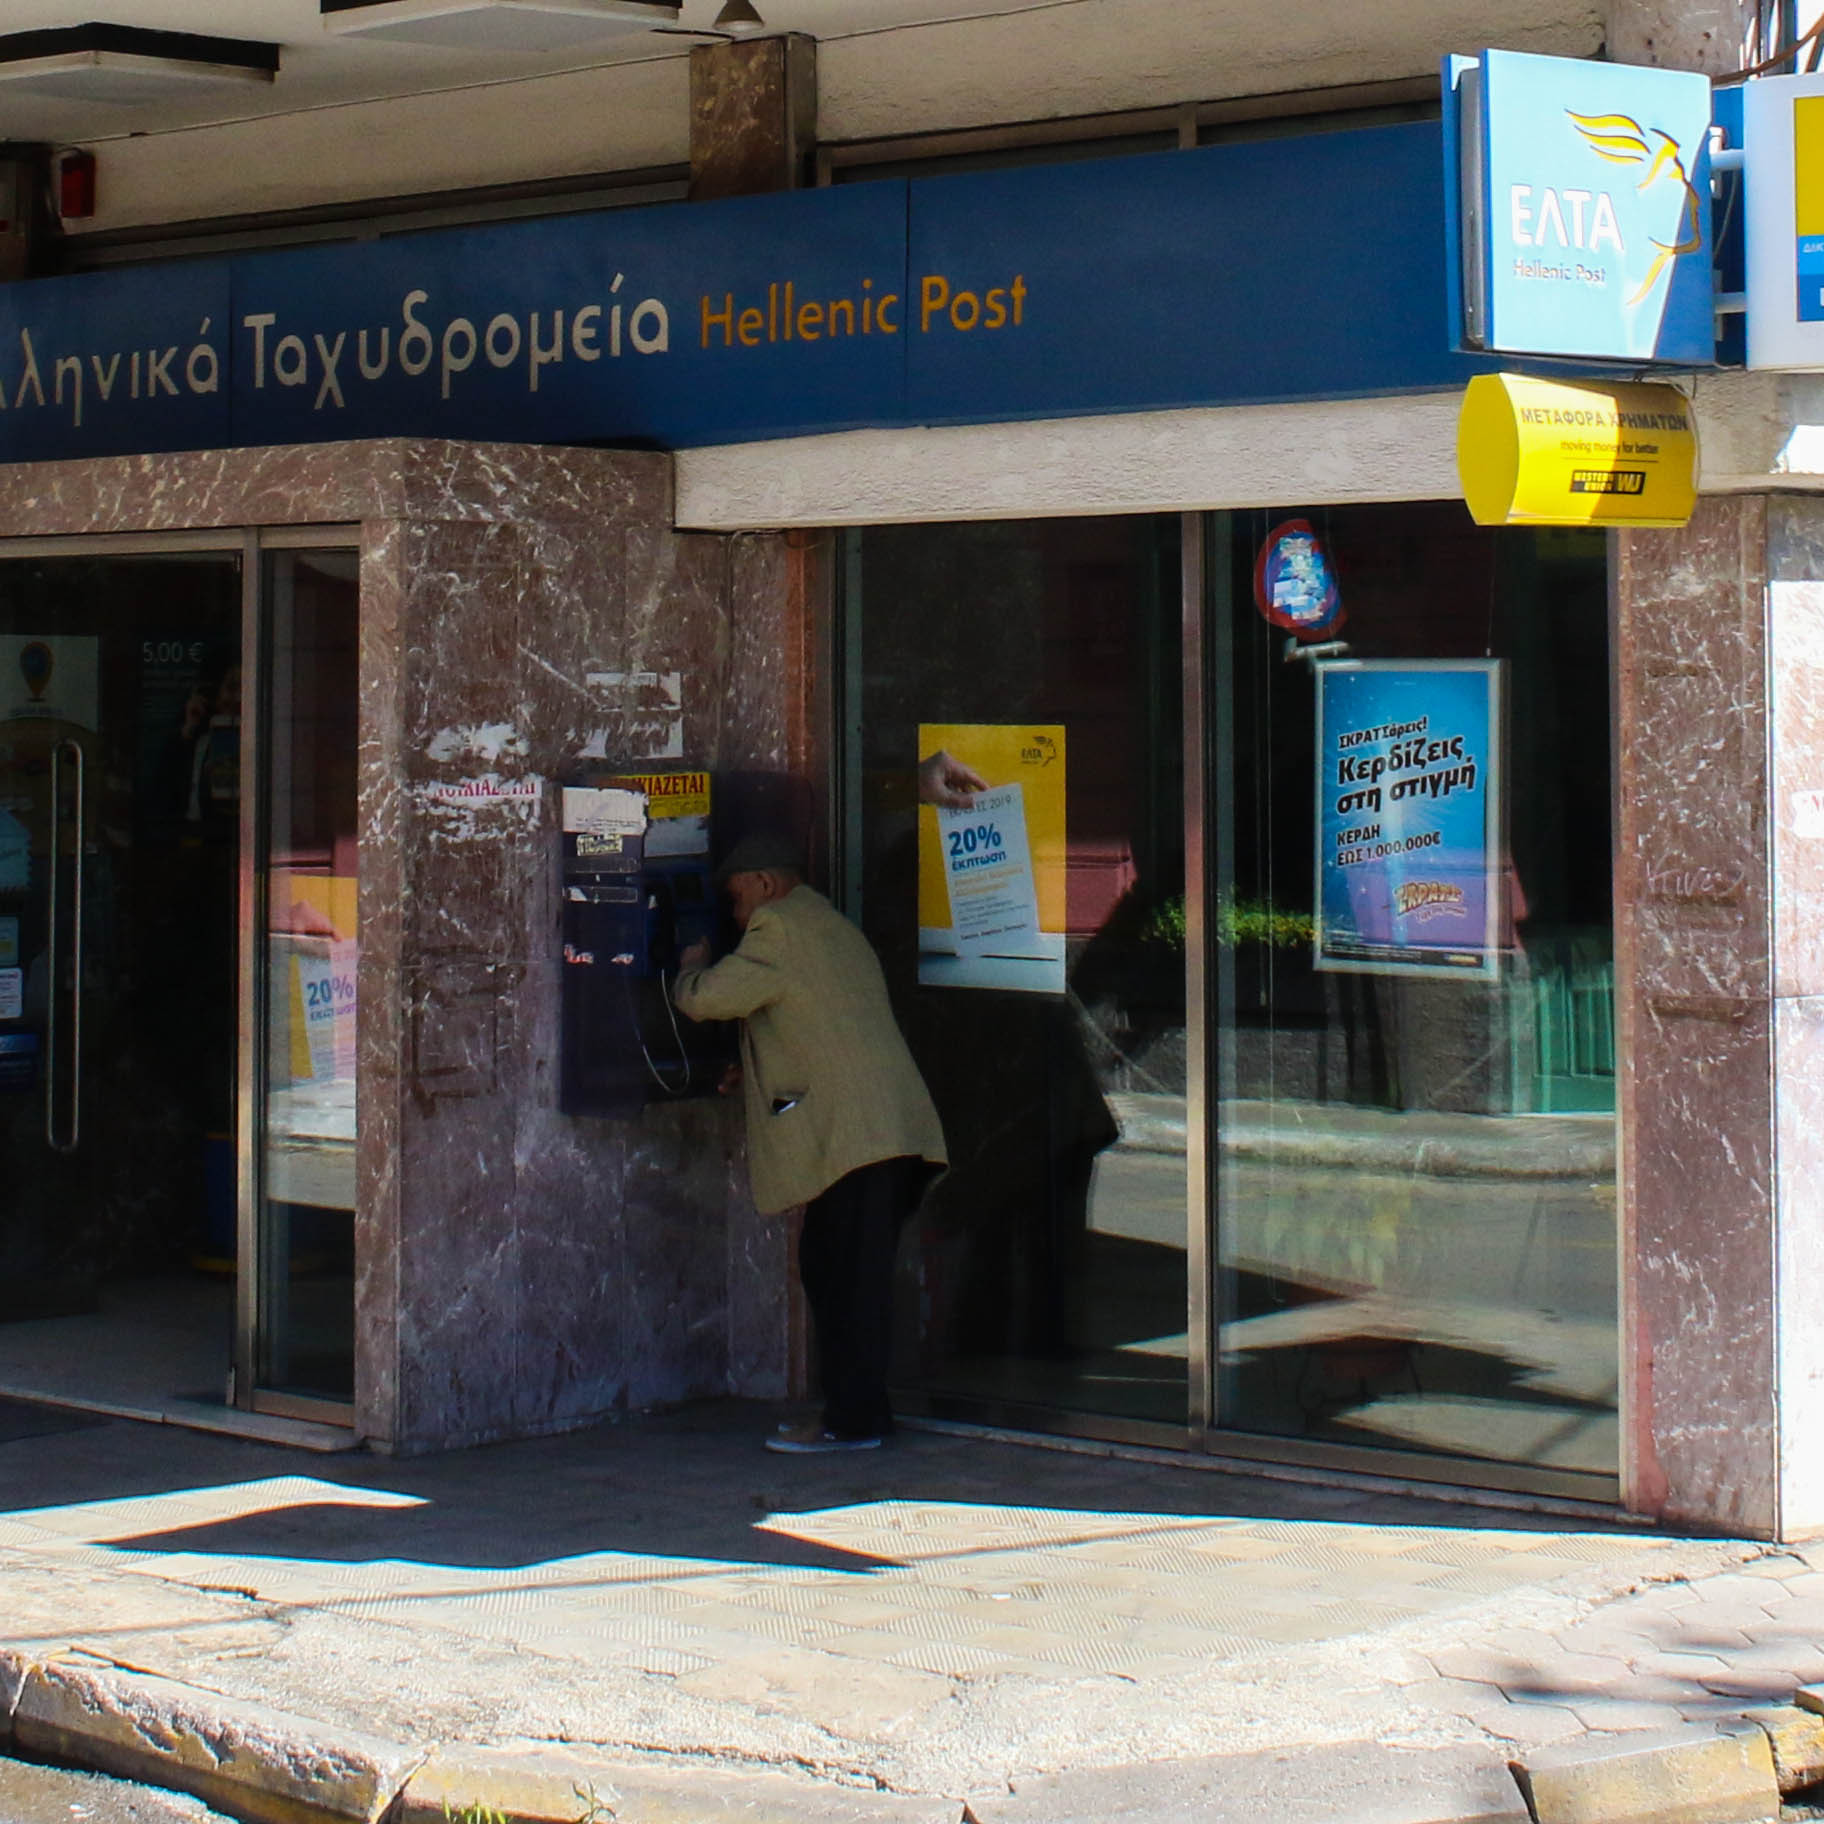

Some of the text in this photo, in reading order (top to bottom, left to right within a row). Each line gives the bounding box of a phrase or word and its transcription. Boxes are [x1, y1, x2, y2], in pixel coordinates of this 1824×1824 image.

[1511, 183, 1625, 253] ΕΛΤΑ
[1513, 258, 1607, 283] Hellenic Post
[701, 274, 1027, 349] Hellenic Post
[243, 273, 670, 410] Ταχυδρομεία
[1520, 407, 1689, 432] ΜΕΤΑΦΟΡΑ ΧΡΗΜΑΤΩΝ
[1561, 440, 1659, 454] moving money for better
[1338, 736, 1464, 785] Κερδίζεις
[1337, 755, 1476, 815] στη στιγμή
[948, 823, 1002, 856] 20%
[1337, 824, 1380, 846] ΚΕΡΔΗ
[1337, 831, 1441, 866] ΕΩΣ 1.000.000€
[307, 975, 354, 1007] 20%
